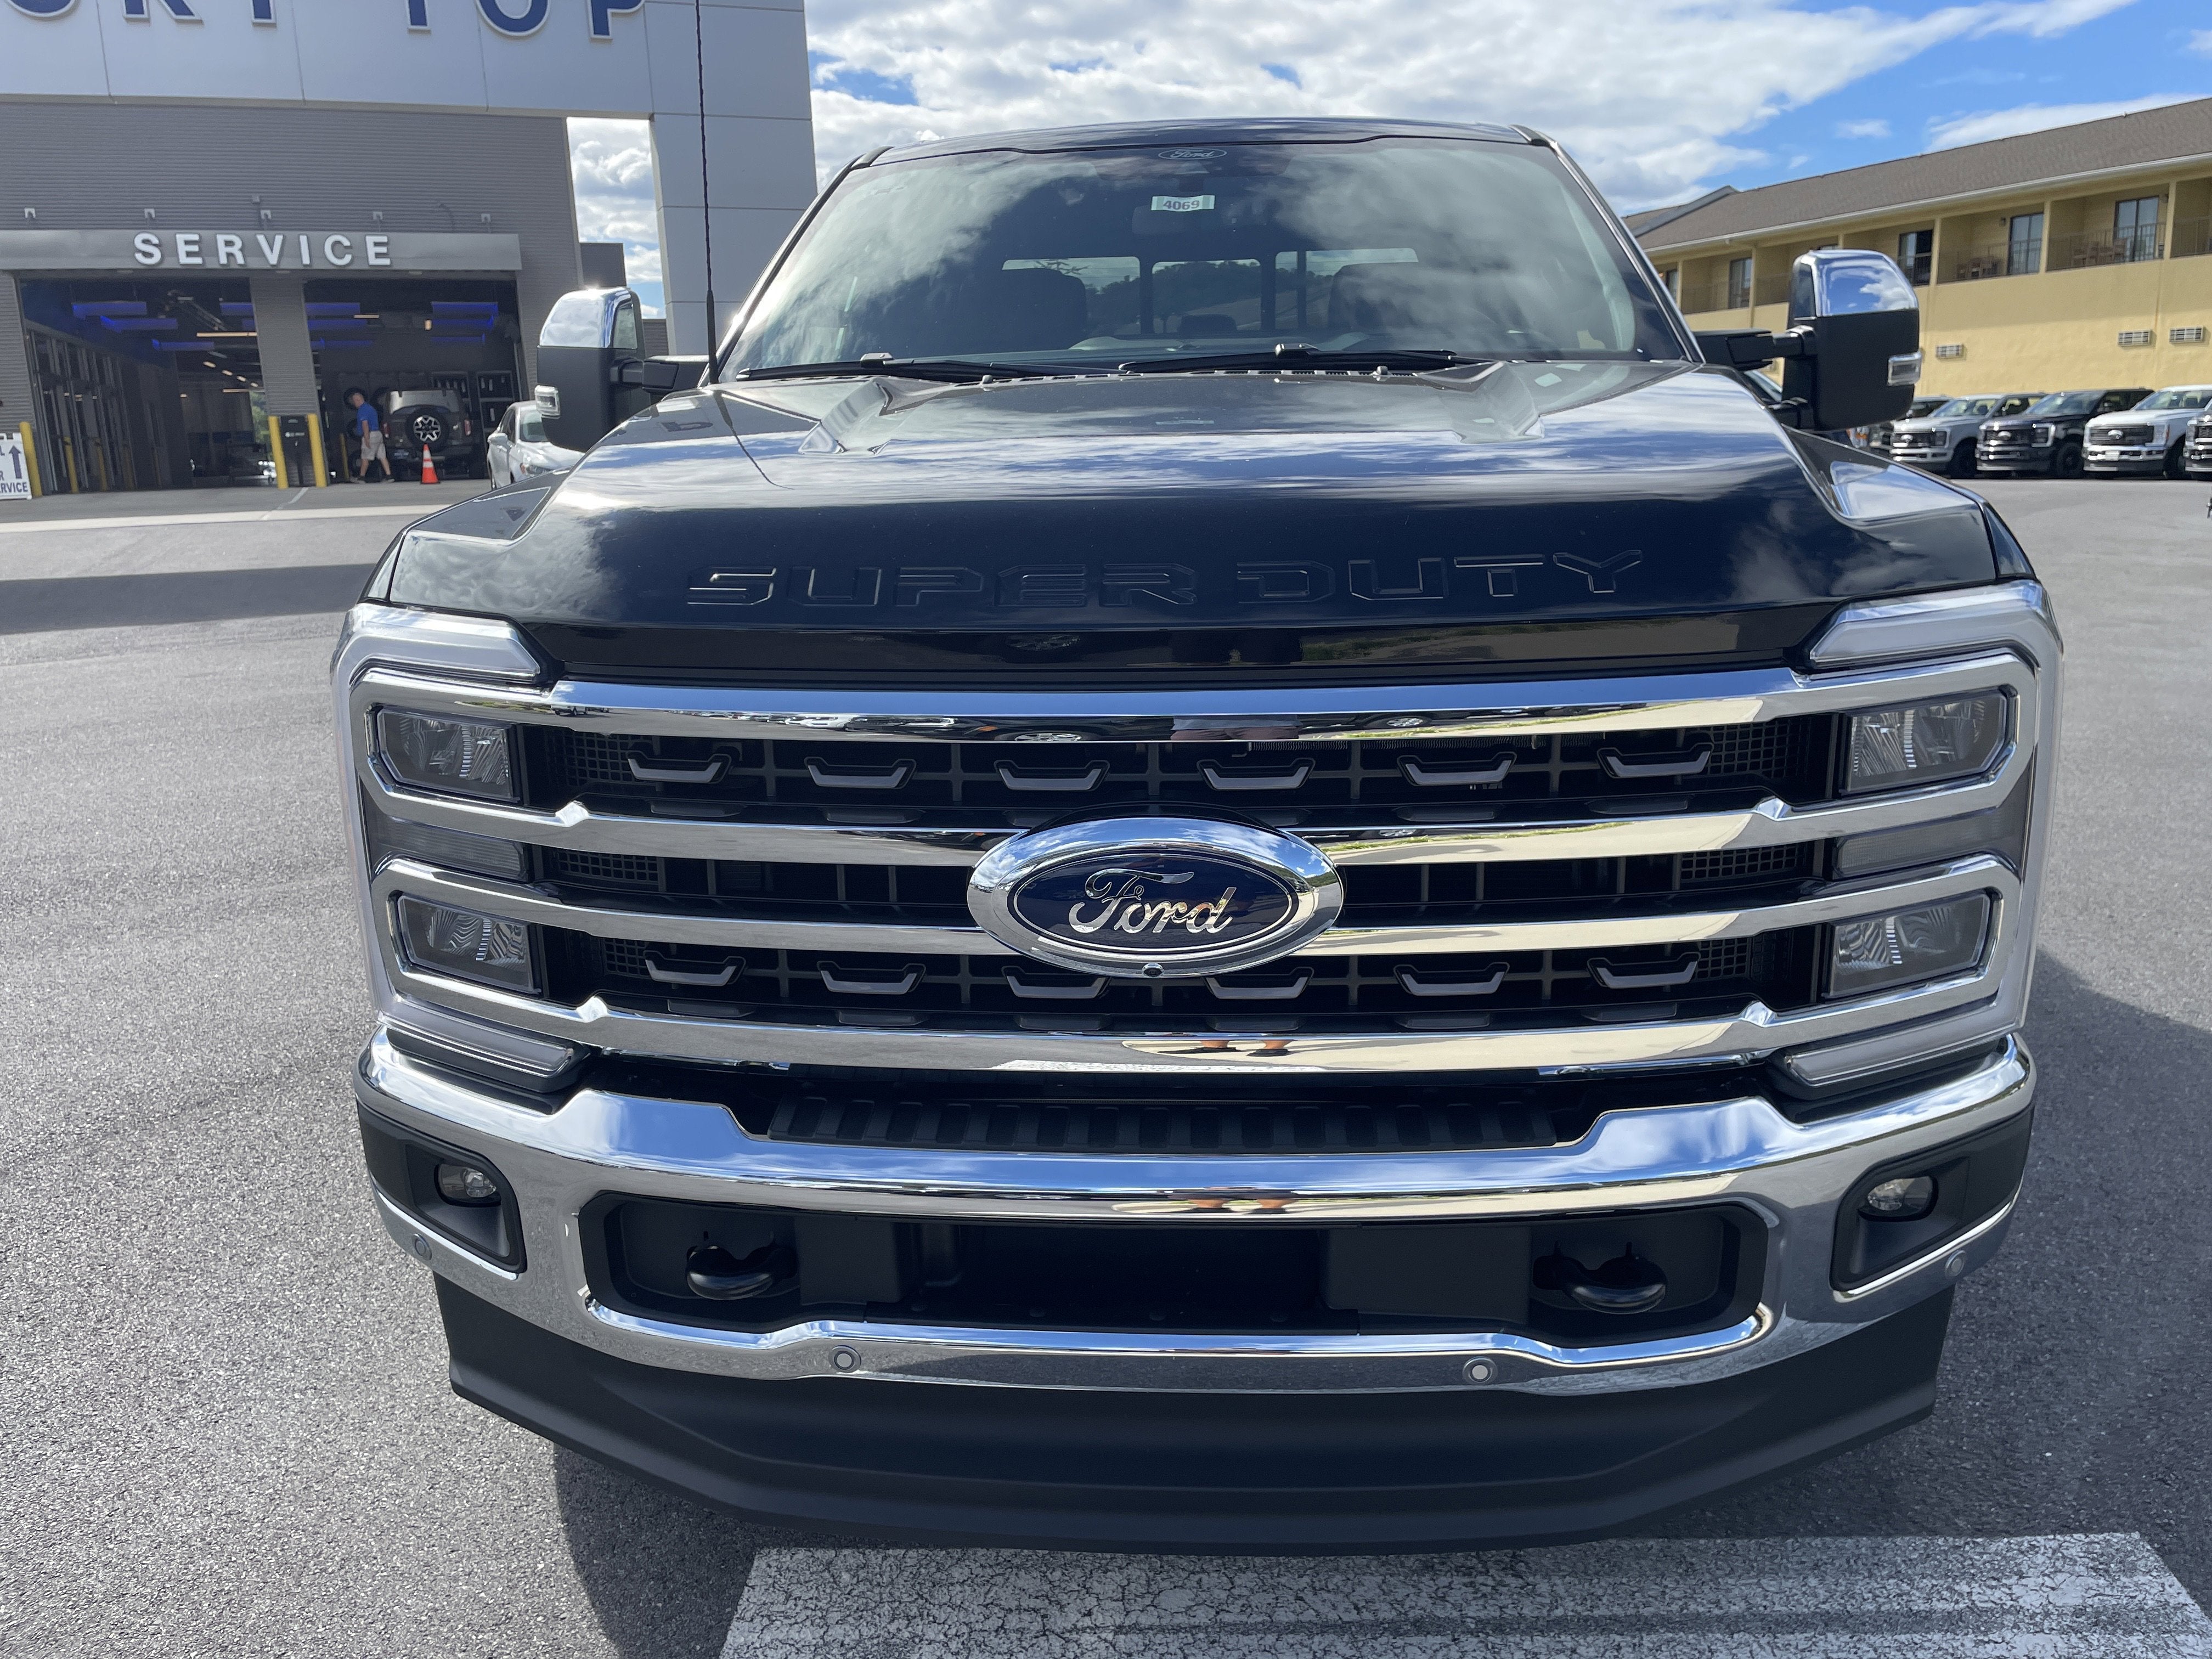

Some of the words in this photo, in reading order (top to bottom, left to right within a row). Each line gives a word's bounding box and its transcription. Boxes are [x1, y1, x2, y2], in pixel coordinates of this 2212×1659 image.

[1170, 149, 1215, 158] Ford
[1164, 200, 1200, 210] 4069
[133, 231, 392, 266] SERVICE
[0, 482, 28, 493] RVICE
[686, 563, 1197, 607] SUPER
[1237, 549, 1643, 604] DUTY
[1069, 868, 1236, 933] Ford
